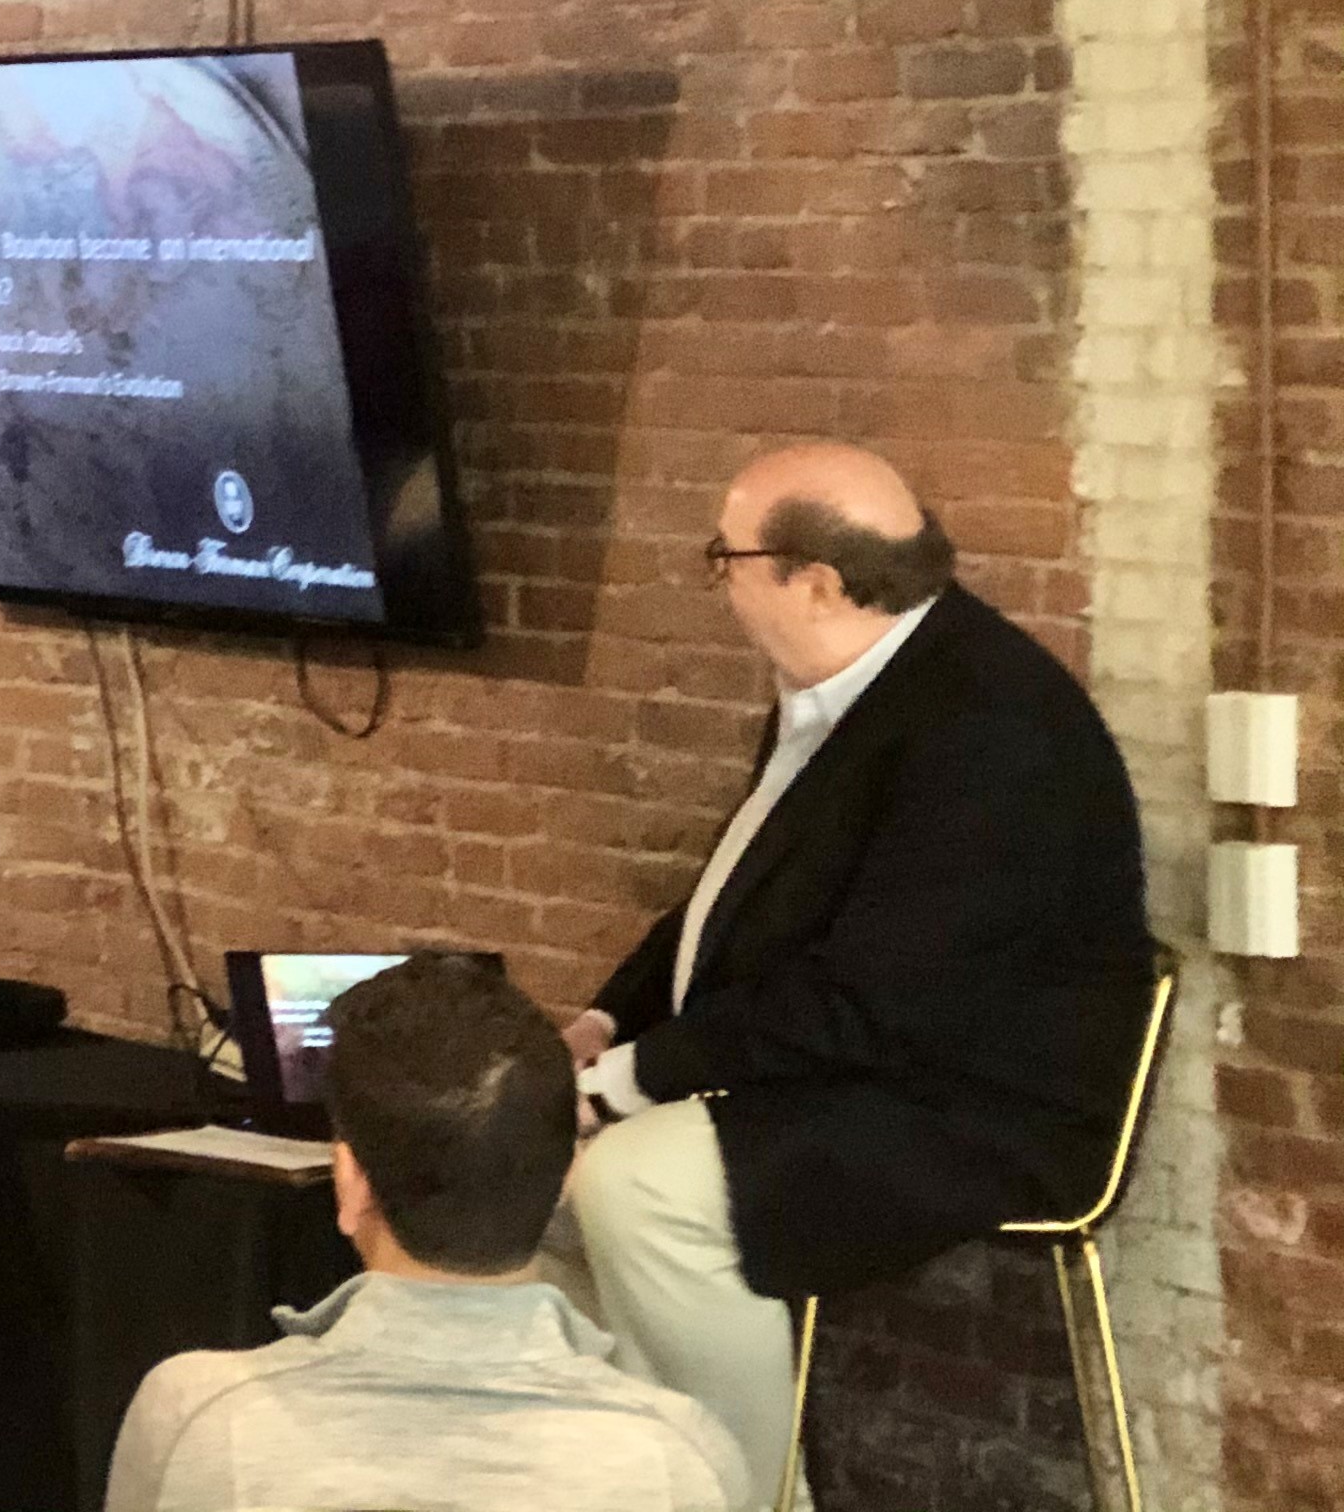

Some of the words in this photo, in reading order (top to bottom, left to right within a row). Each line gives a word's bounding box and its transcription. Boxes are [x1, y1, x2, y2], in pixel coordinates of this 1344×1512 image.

[1, 231, 77, 260] Bourbon
[79, 230, 152, 260] become
[187, 228, 315, 261] international
